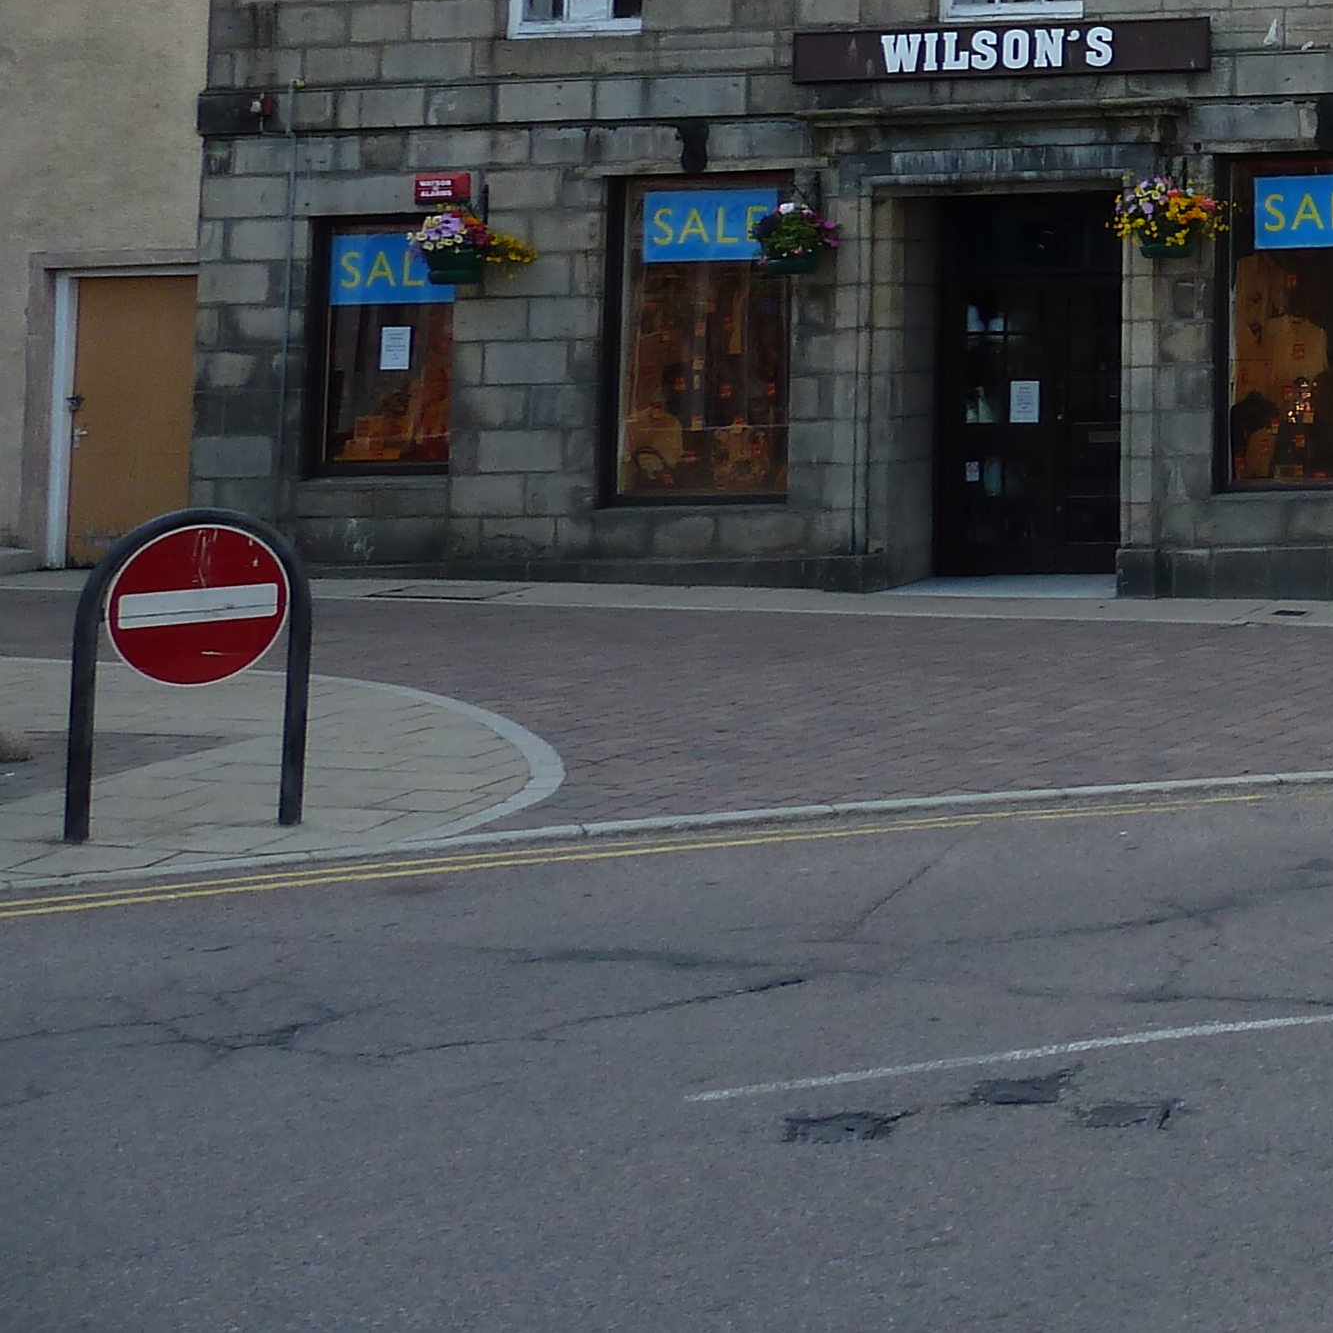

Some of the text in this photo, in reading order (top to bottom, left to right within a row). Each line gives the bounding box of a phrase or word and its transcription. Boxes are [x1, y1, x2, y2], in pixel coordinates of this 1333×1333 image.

[880, 26, 1113, 74] WILSON'S
[653, 206, 768, 246] SALE
[341, 251, 425, 289] SAL
